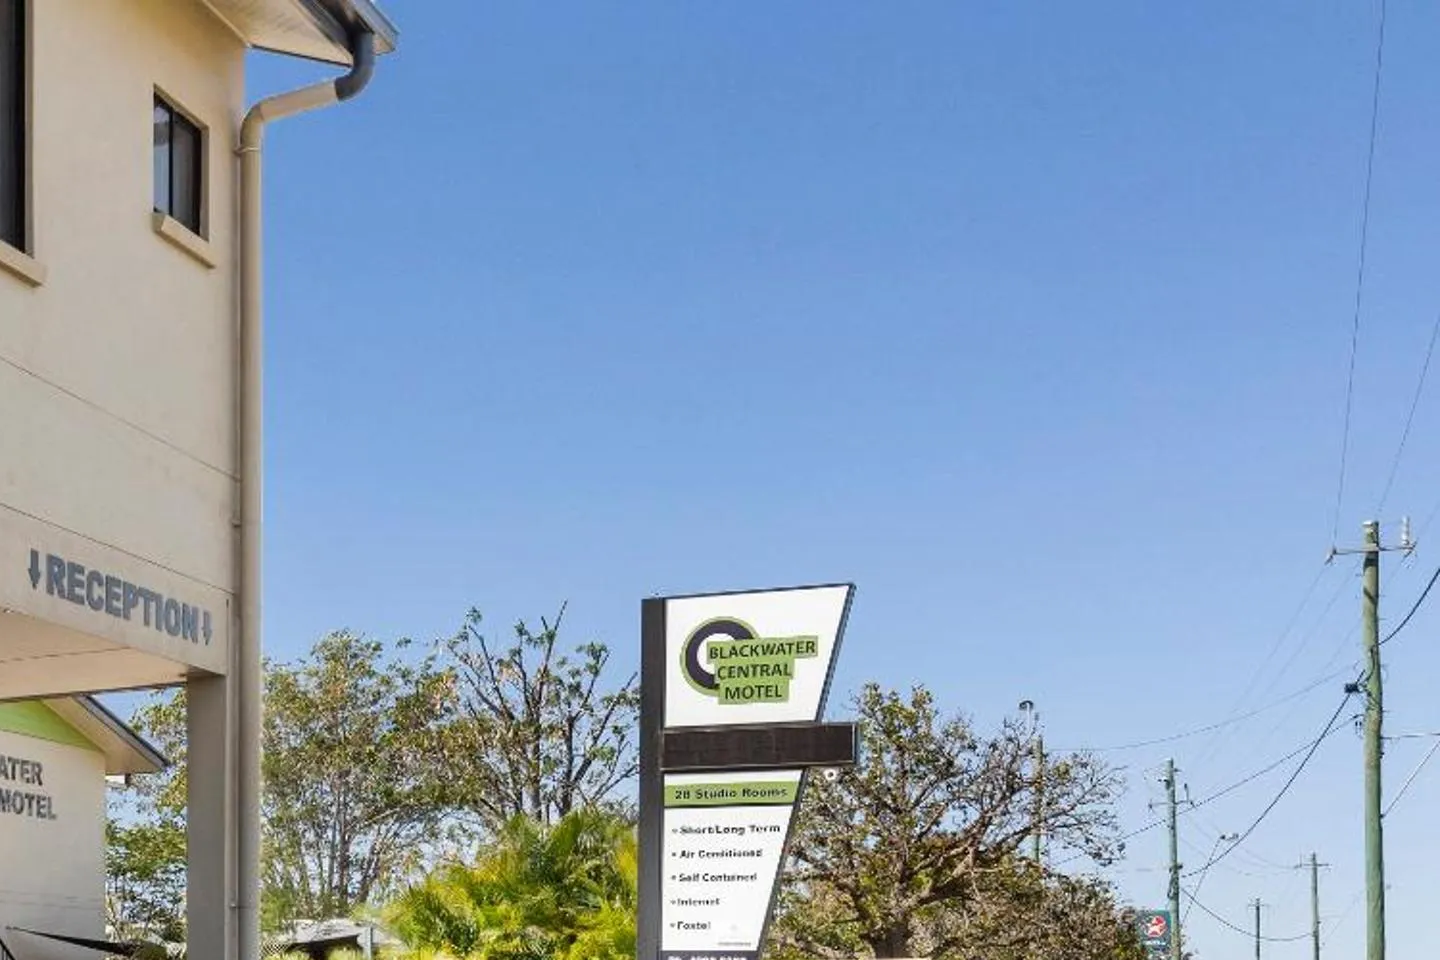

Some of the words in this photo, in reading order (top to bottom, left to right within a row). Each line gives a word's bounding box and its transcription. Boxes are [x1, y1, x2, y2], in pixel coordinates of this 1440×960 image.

[46, 553, 199, 643] RECEPTION
[709, 640, 816, 659] BLACKWATER
[717, 663, 792, 680] CENTRAL
[725, 685, 782, 699] MOTEL
[695, 788, 737, 799] Studio
[742, 787, 788, 798] Rooms
[679, 850, 695, 858] Air
[678, 873, 700, 882] Self
